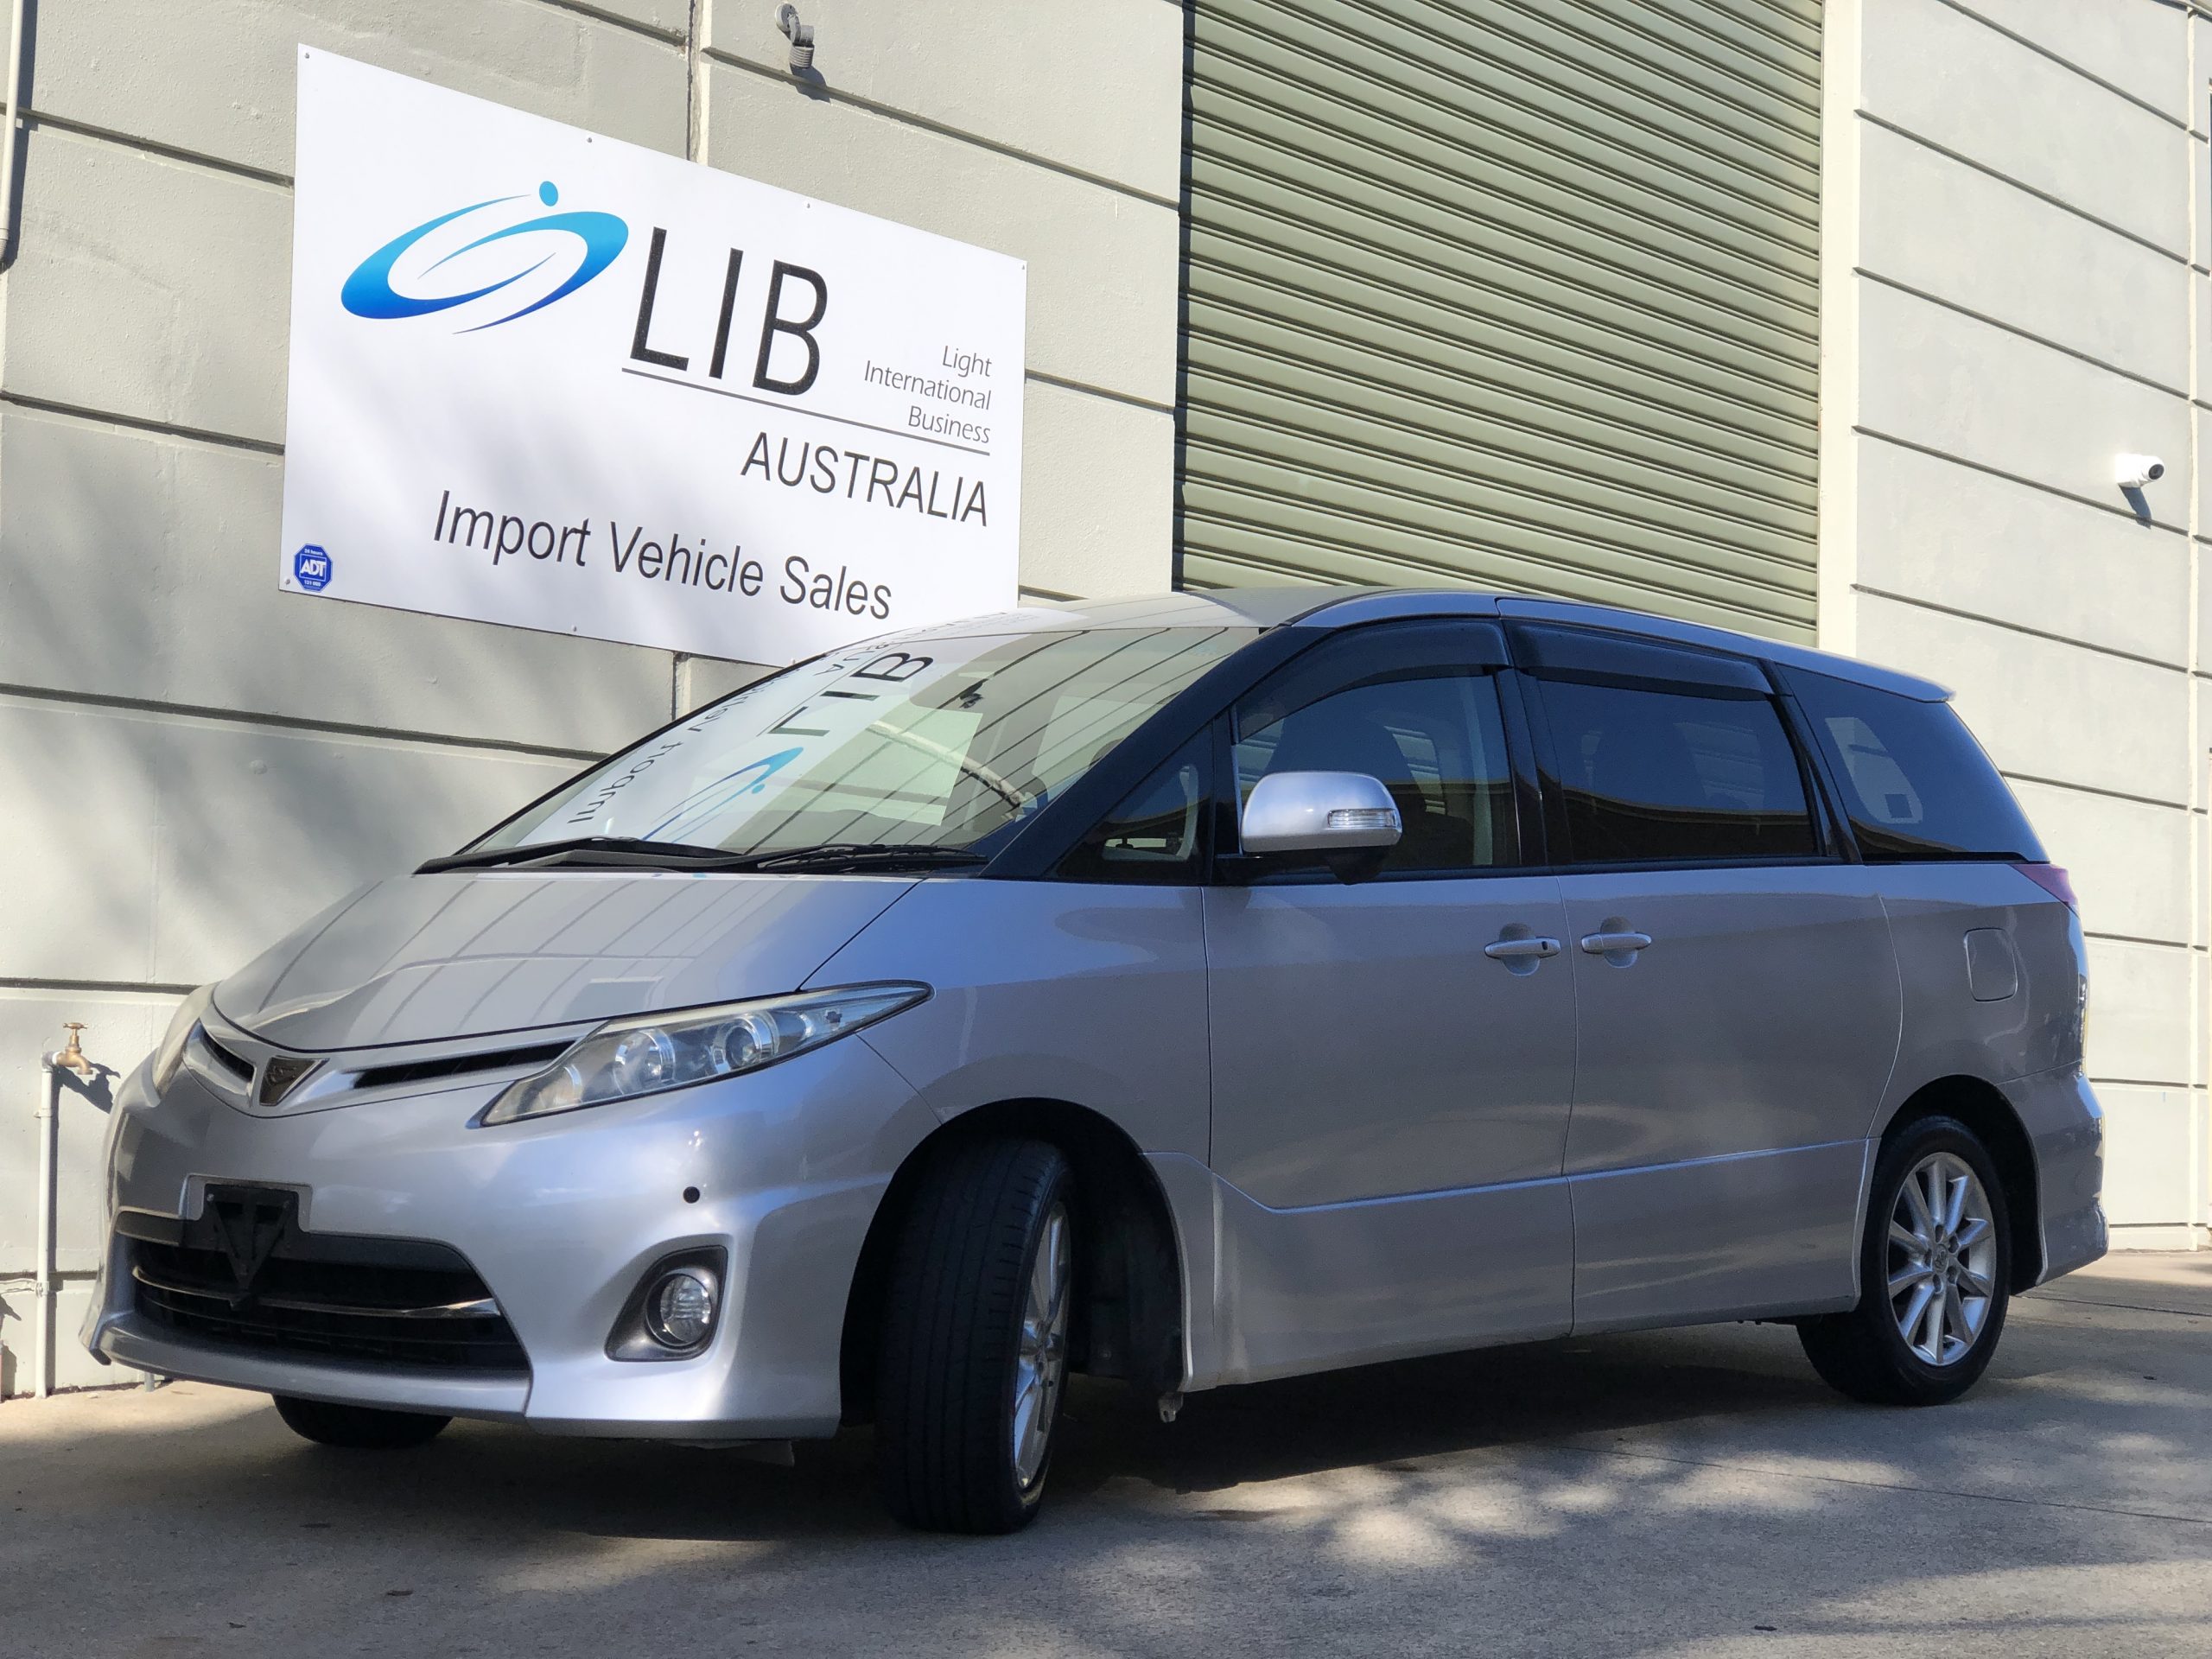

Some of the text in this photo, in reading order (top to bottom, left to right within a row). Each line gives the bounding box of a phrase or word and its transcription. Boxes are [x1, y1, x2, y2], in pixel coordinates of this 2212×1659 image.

[630, 226, 829, 397] LIB
[864, 359, 992, 410] International
[942, 345, 993, 378] Light
[908, 405, 991, 444] Business
[741, 432, 987, 527] AUSTRALIA
[300, 558, 327, 577] ADT
[434, 490, 893, 620] Import Vehicle Sales
